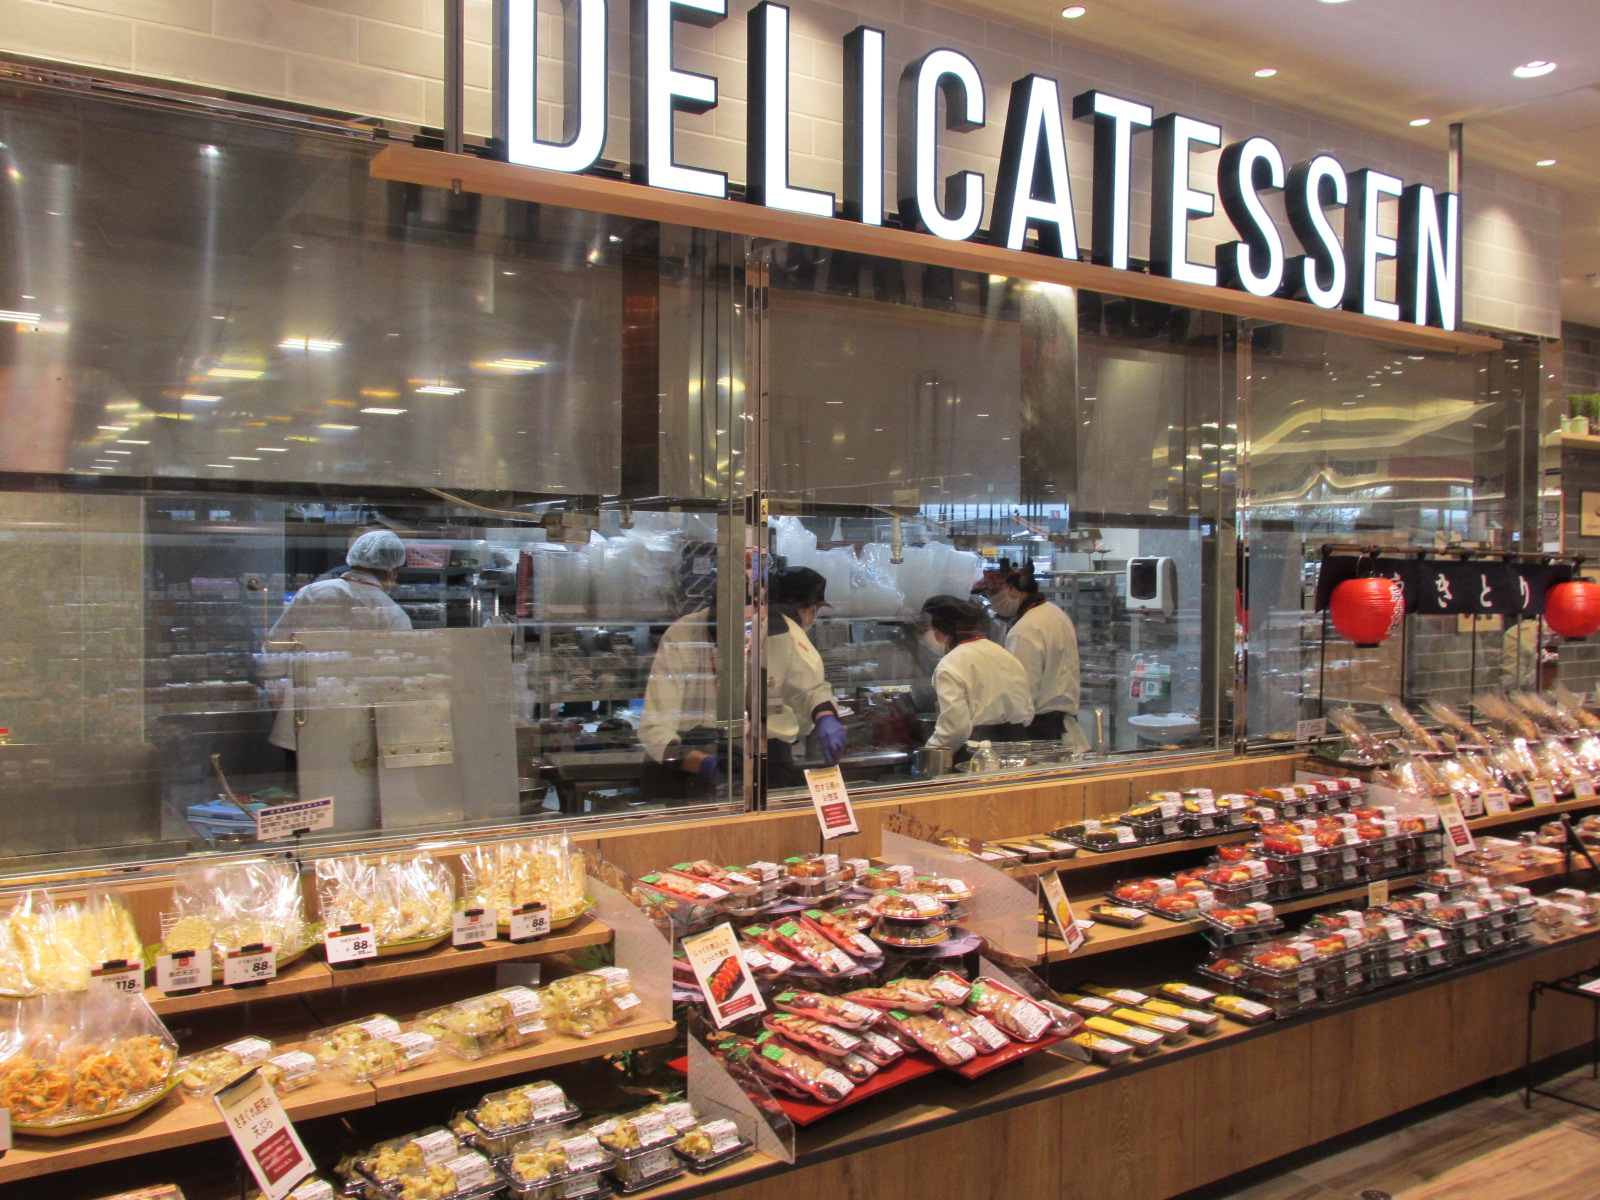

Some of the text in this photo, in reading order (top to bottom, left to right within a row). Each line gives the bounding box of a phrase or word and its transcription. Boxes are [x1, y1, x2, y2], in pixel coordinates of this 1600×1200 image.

[495, 0, 1459, 332] DELICATESSEN
[532, 917, 545, 928] 88
[353, 940, 368, 951] 88
[252, 961, 269, 972] 88
[116, 979, 136, 991] 118
